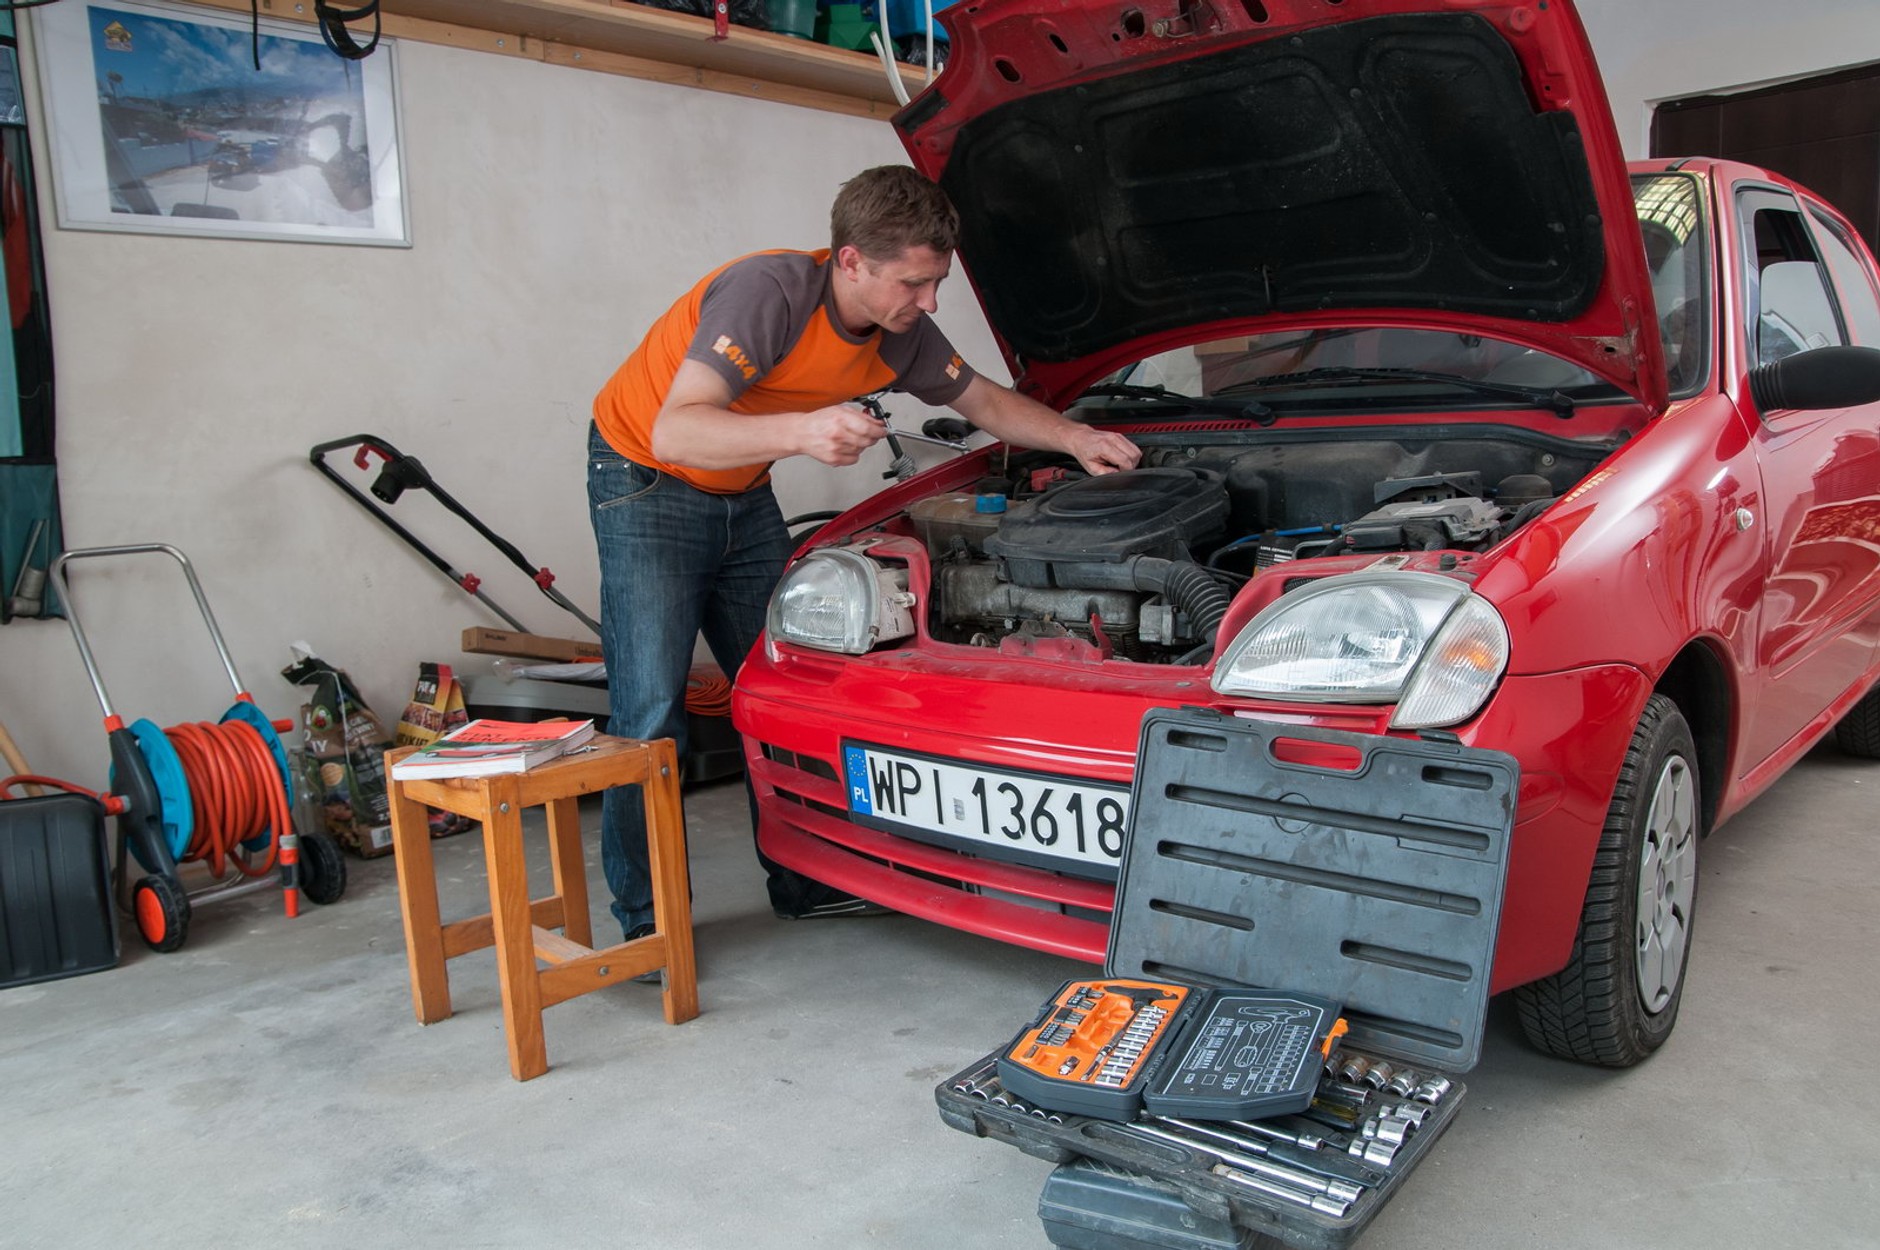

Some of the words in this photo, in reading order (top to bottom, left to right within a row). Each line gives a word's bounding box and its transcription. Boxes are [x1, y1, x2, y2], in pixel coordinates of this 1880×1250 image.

[854, 786, 869, 803] PL
[868, 757, 944, 825] WPI
[971, 777, 1126, 858] 13618
